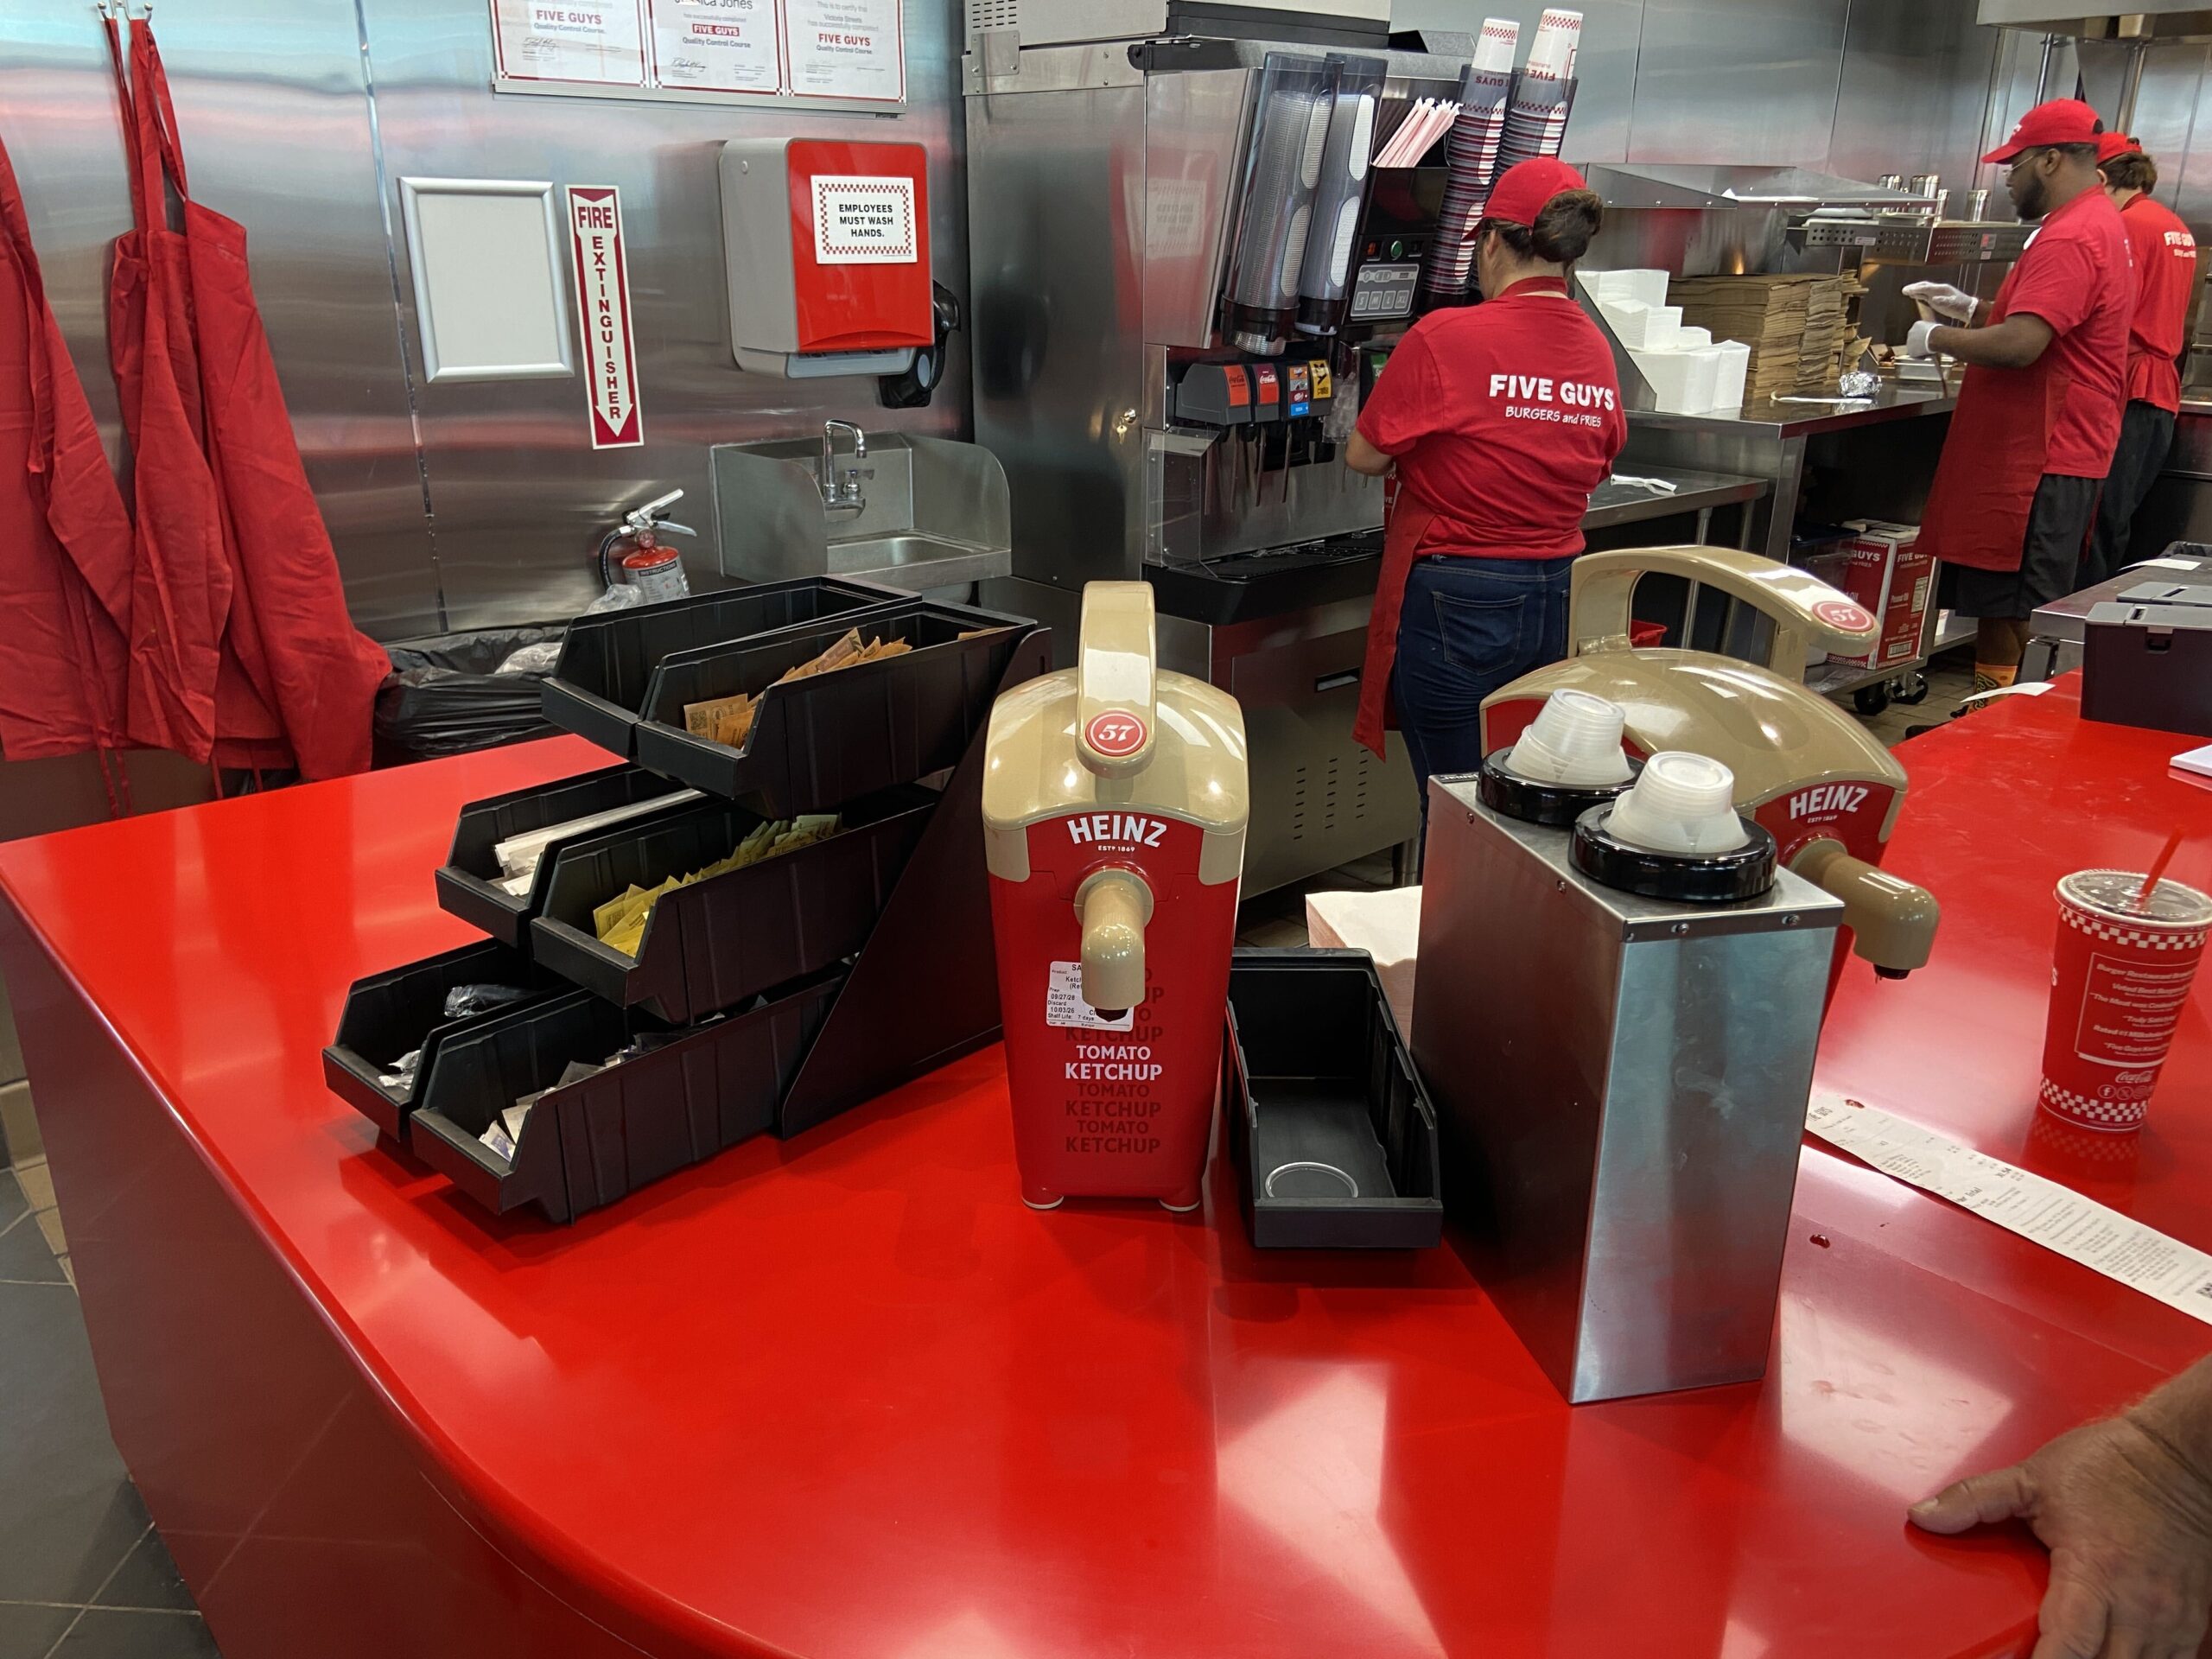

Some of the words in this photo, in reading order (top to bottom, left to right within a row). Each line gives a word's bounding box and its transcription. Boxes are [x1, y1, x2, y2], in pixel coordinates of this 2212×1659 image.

[536, 10, 564, 22] FIVE
[568, 12, 602, 25] GUYS
[534, 22, 558, 31] Quality
[694, 25, 715, 35] FIVE
[715, 27, 739, 36] GUYS
[683, 36, 705, 46] Quality
[729, 40, 751, 48] Course
[818, 33, 842, 44] FIVE
[844, 35, 871, 47] GUYS
[816, 44, 835, 53] Quality
[839, 204, 893, 213] EMPLOYEES
[577, 206, 613, 229] FIRE
[839, 216, 866, 226] MUST
[868, 216, 893, 226] WASH
[851, 229, 885, 238] HANDS.
[592, 236, 621, 419] EXTINGUISHER
[1489, 374, 1554, 402] FIVE
[1560, 382, 1615, 411] GUYS
[1505, 406, 1560, 423] BURGERS
[1562, 414, 1580, 424] and
[1580, 415, 1601, 428] FRIES
[1830, 608, 1857, 622] 57
[1098, 724, 1135, 742] 57
[1789, 785, 1869, 820] HEINZ
[1067, 815, 1167, 848] HEINZ
[1076, 1046, 1151, 1060] TOMATO
[1065, 1063, 1162, 1081] KETCHUP
[1077, 1084, 1150, 1097] TOMATO
[1065, 1100, 1161, 1117] KETCHUP
[1077, 1120, 1149, 1134] TOMATO
[1066, 1137, 1160, 1154] KETCHUP
